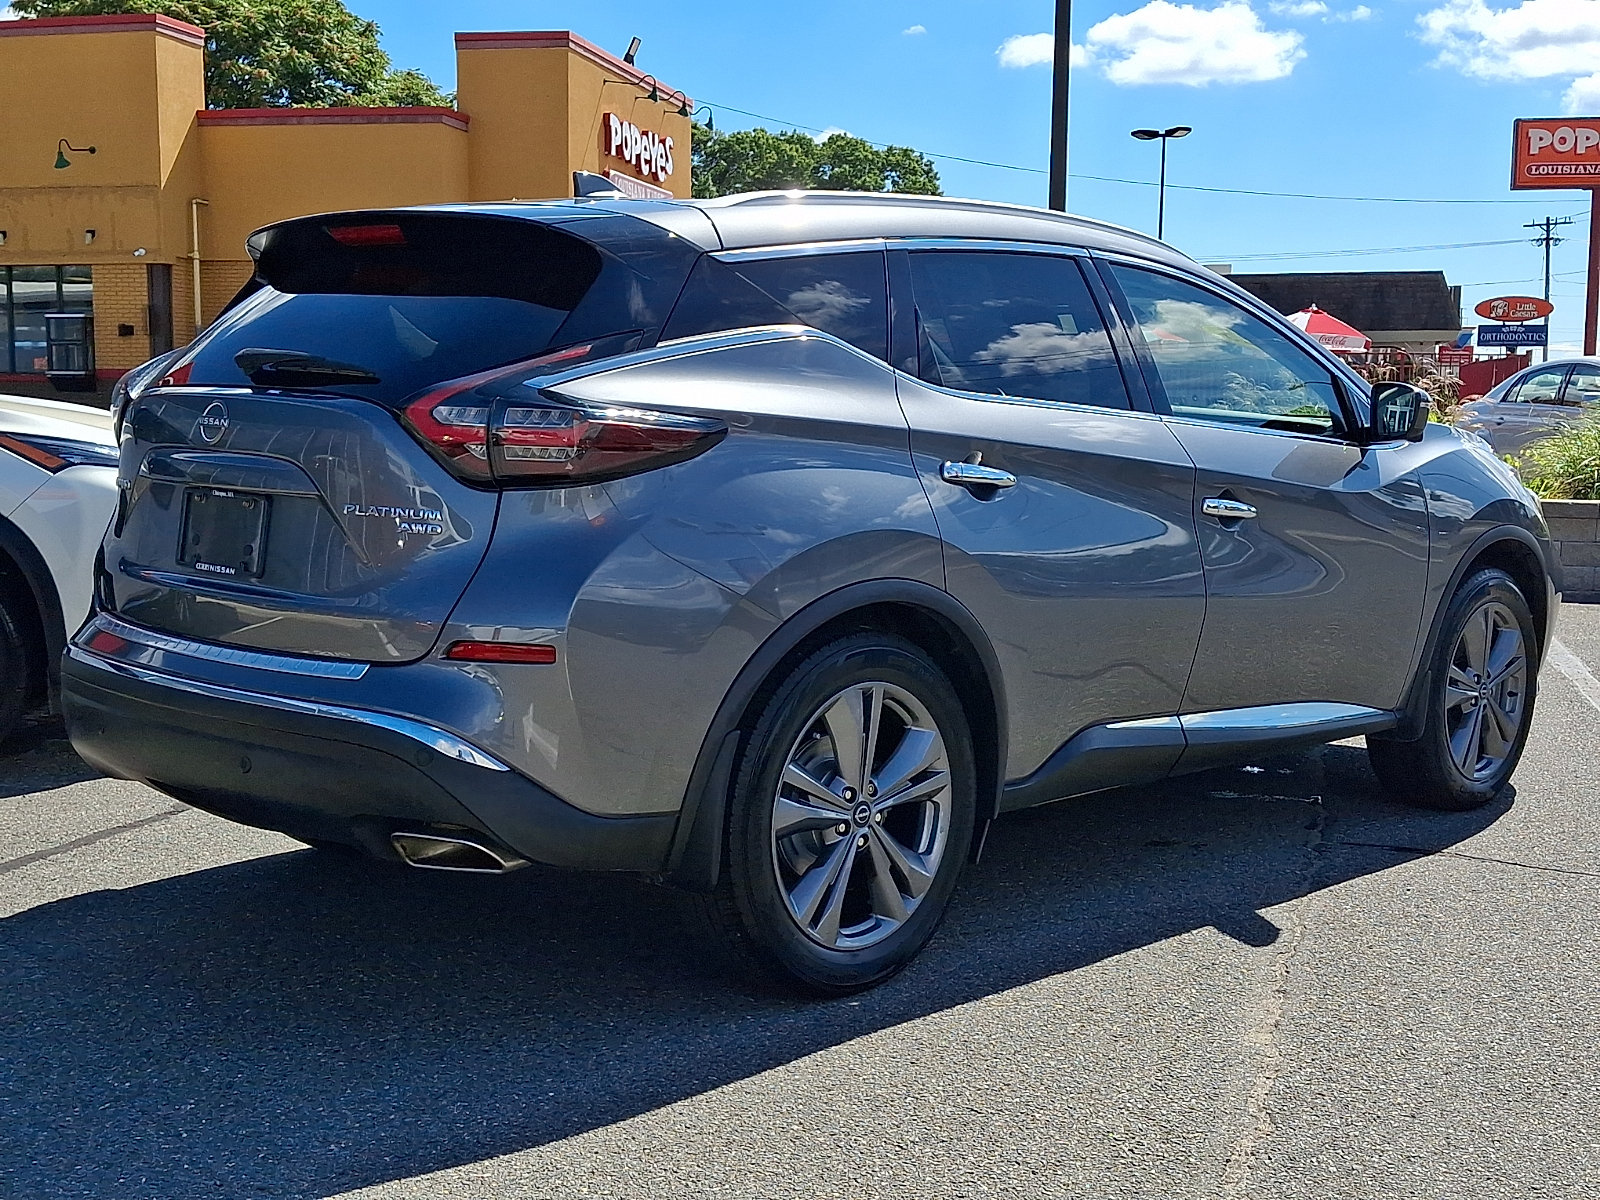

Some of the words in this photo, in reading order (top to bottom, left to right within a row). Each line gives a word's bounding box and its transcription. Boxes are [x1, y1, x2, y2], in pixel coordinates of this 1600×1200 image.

[1528, 126, 1600, 155] POP
[1516, 302, 1537, 311] Little
[1510, 309, 1539, 318] Caesars
[1480, 332, 1546, 341] ORTHODONTICS
[343, 504, 442, 521] PLATINUM
[397, 521, 443, 535] AWD
[209, 563, 236, 576] NISSAN
